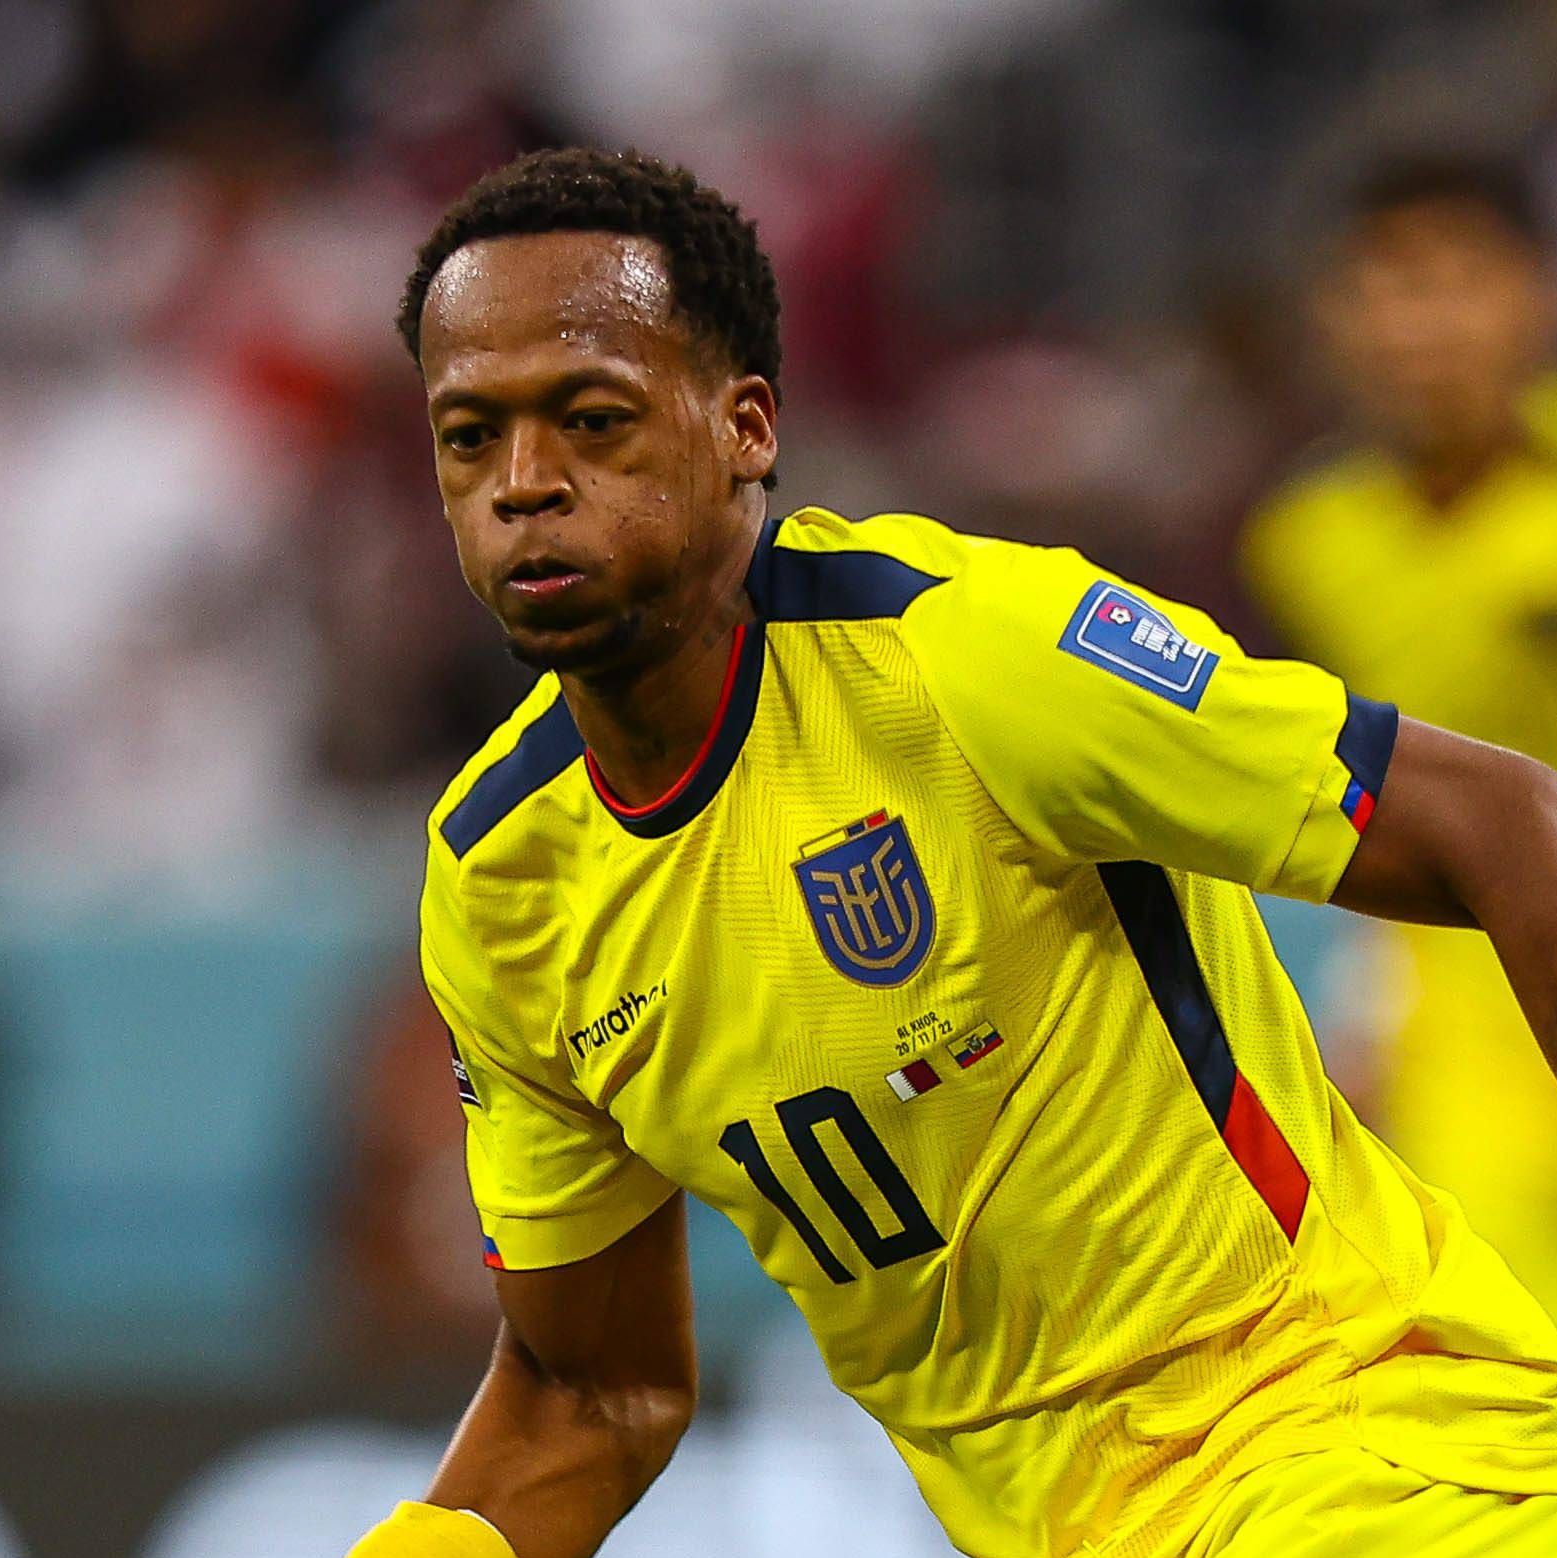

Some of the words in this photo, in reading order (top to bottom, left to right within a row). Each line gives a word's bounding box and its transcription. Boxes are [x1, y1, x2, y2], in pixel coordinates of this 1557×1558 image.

[897, 1025, 910, 1039] AL
[909, 1011, 939, 1033] KHOR
[718, 1086, 948, 1285] 10
